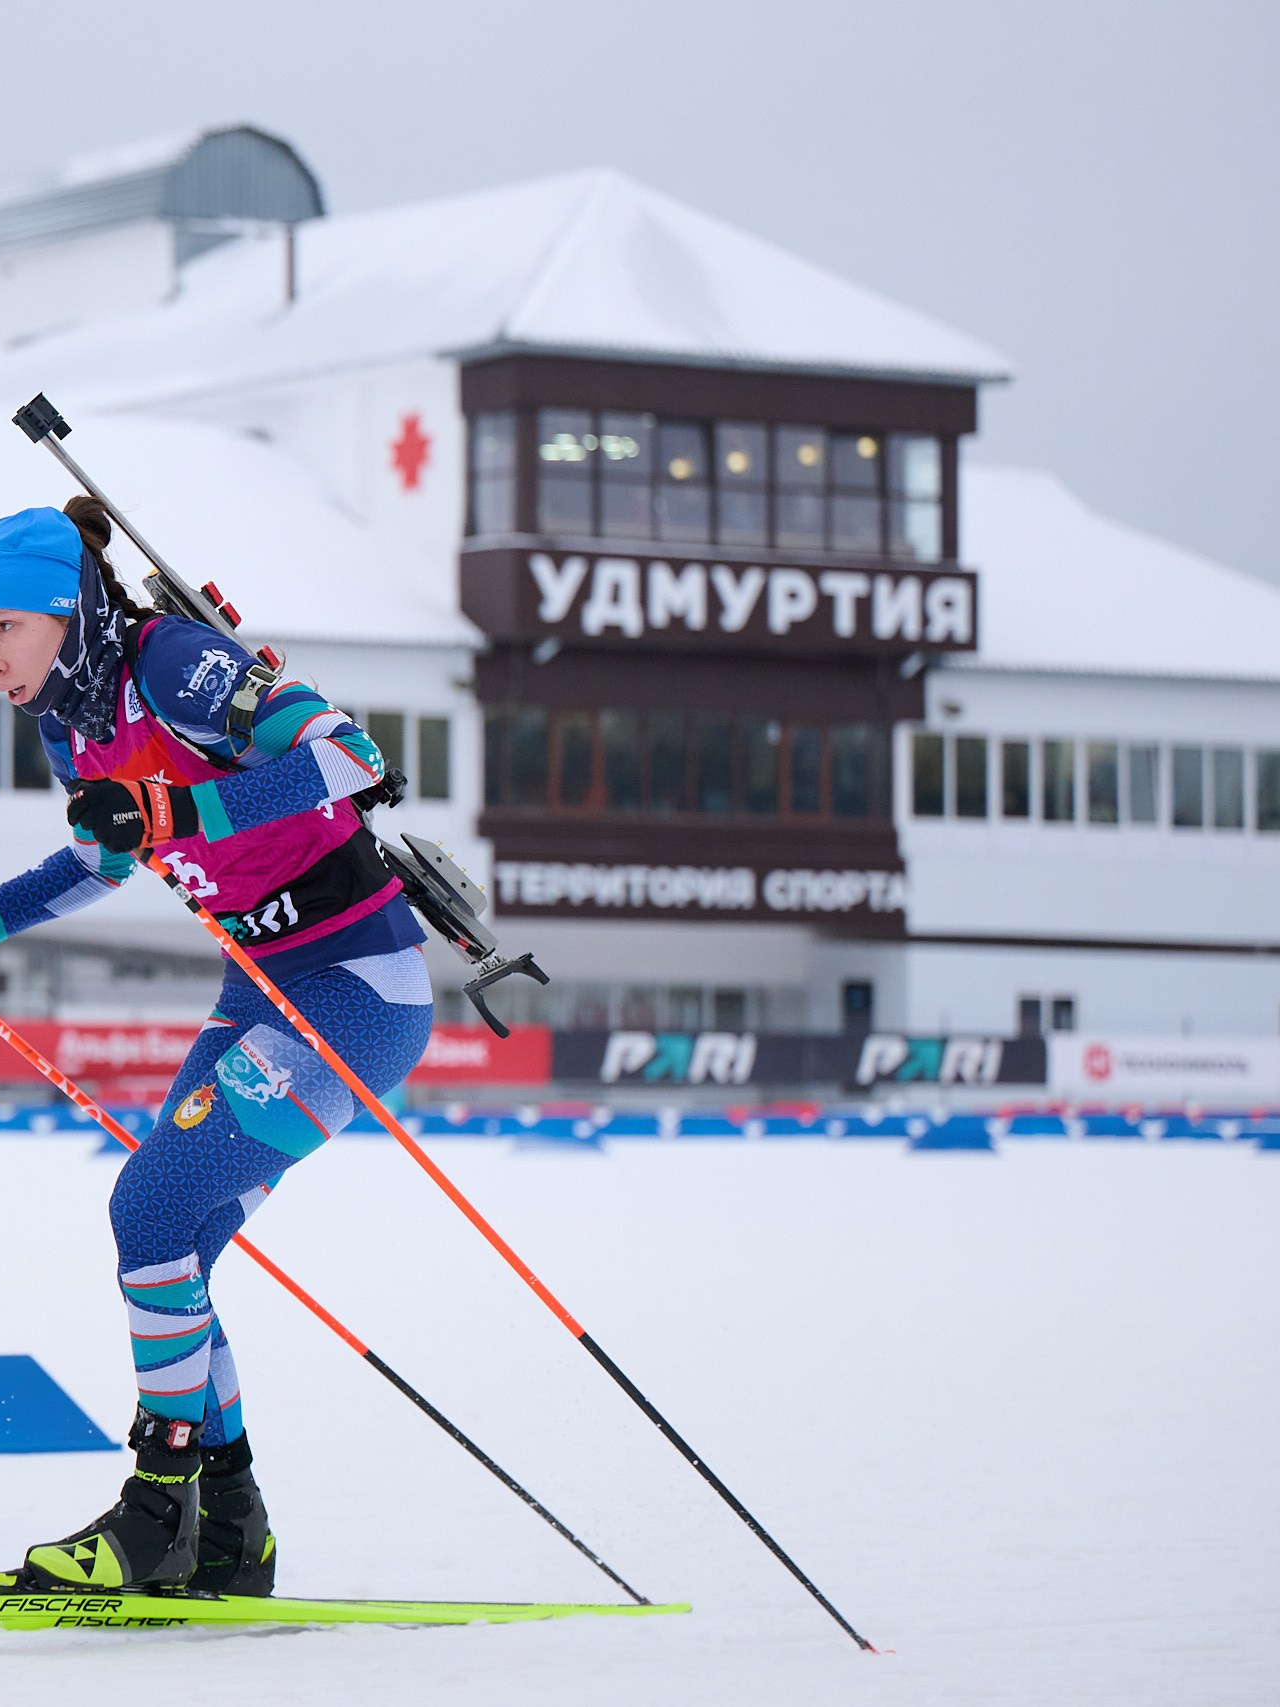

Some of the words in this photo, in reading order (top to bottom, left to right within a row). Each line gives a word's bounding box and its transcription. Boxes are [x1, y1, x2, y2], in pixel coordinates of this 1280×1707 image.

[528, 552, 973, 646] УДМУРТИЯ
[496, 861, 756, 908] ТЕРРИТОРИЯ
[762, 869, 908, 913] СПОРТА
[600, 1031, 757, 1084] PARI
[855, 1034, 1002, 1085] PARI
[136, 1469, 185, 1484] SCHER
